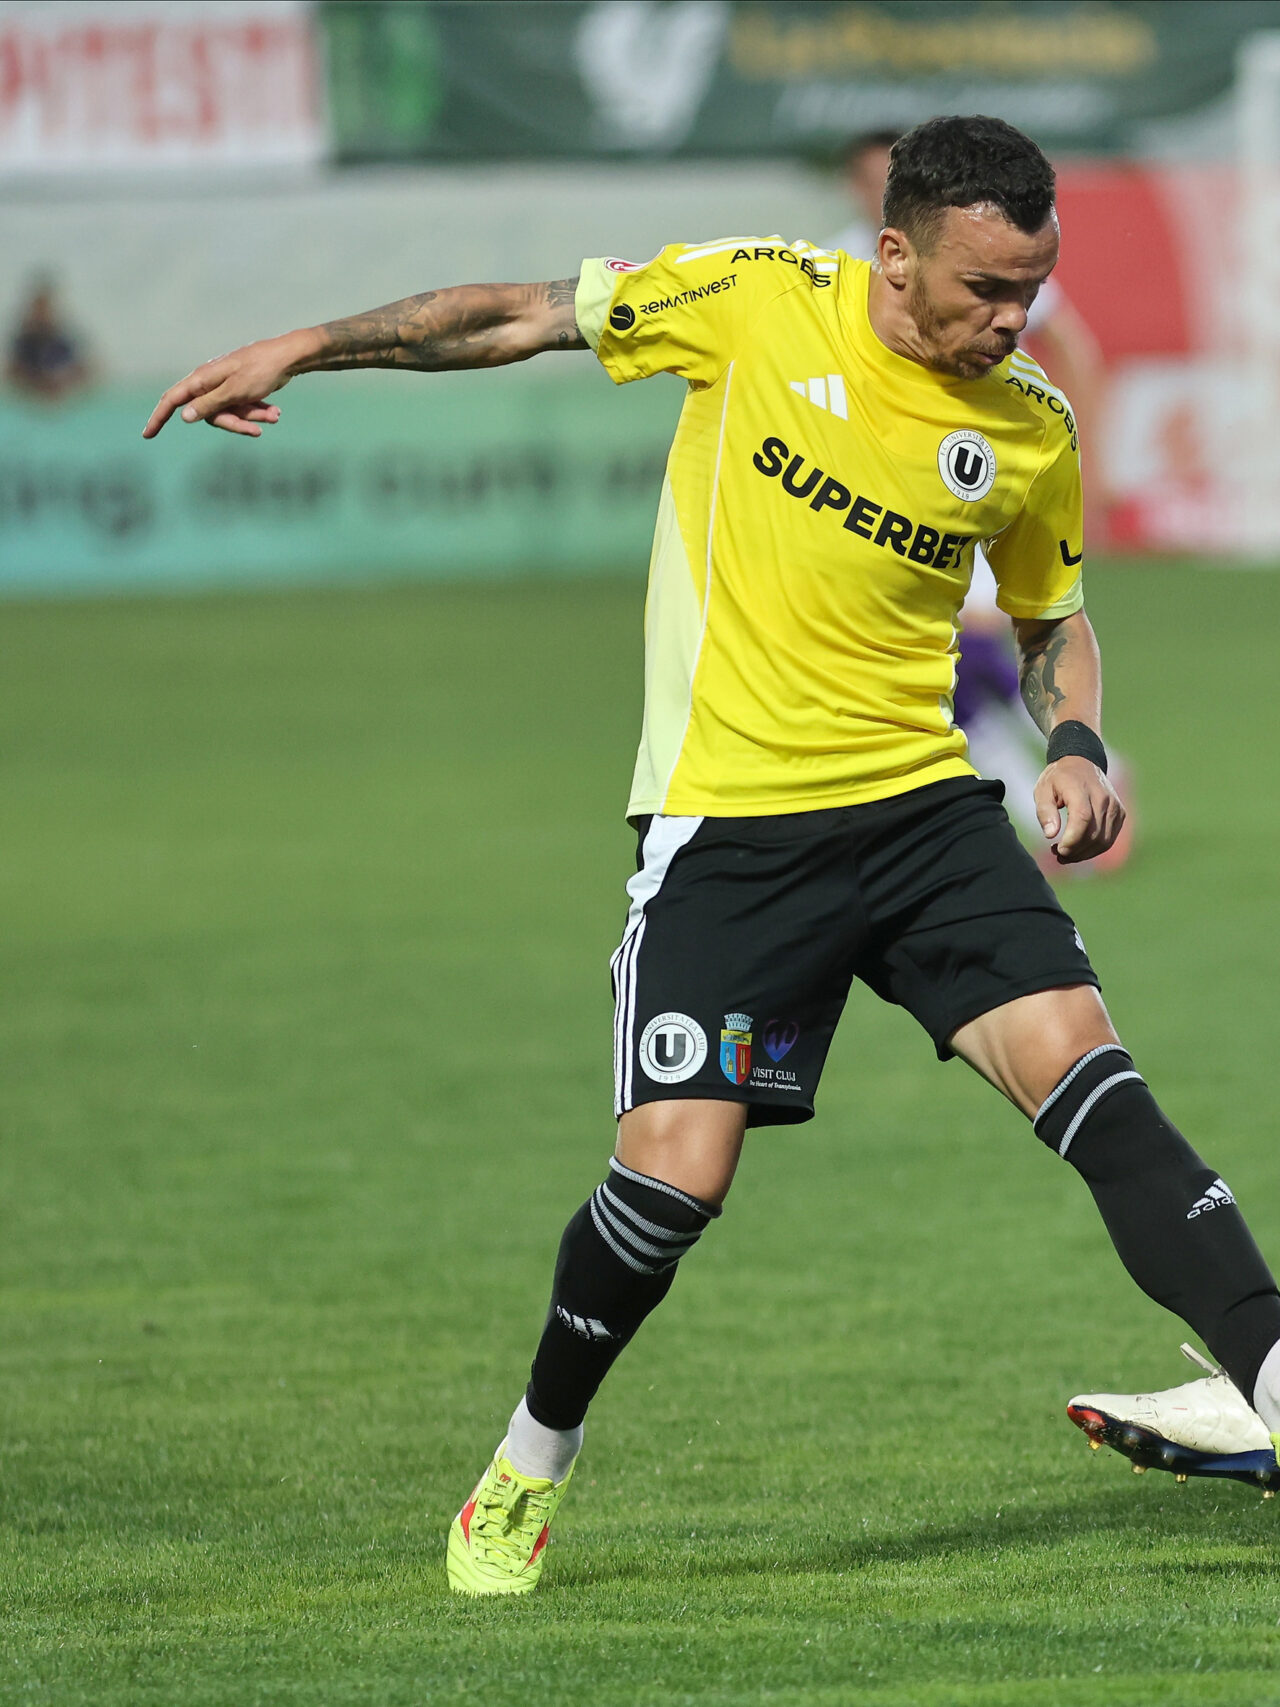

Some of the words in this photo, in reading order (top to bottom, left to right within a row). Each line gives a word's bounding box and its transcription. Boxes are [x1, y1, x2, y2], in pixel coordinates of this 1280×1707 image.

[953, 445, 984, 487] U
[752, 436, 974, 570] SUPERBET
[655, 1032, 687, 1068] U
[752, 1066, 774, 1080] VISIT
[775, 1070, 796, 1082] CLUJ
